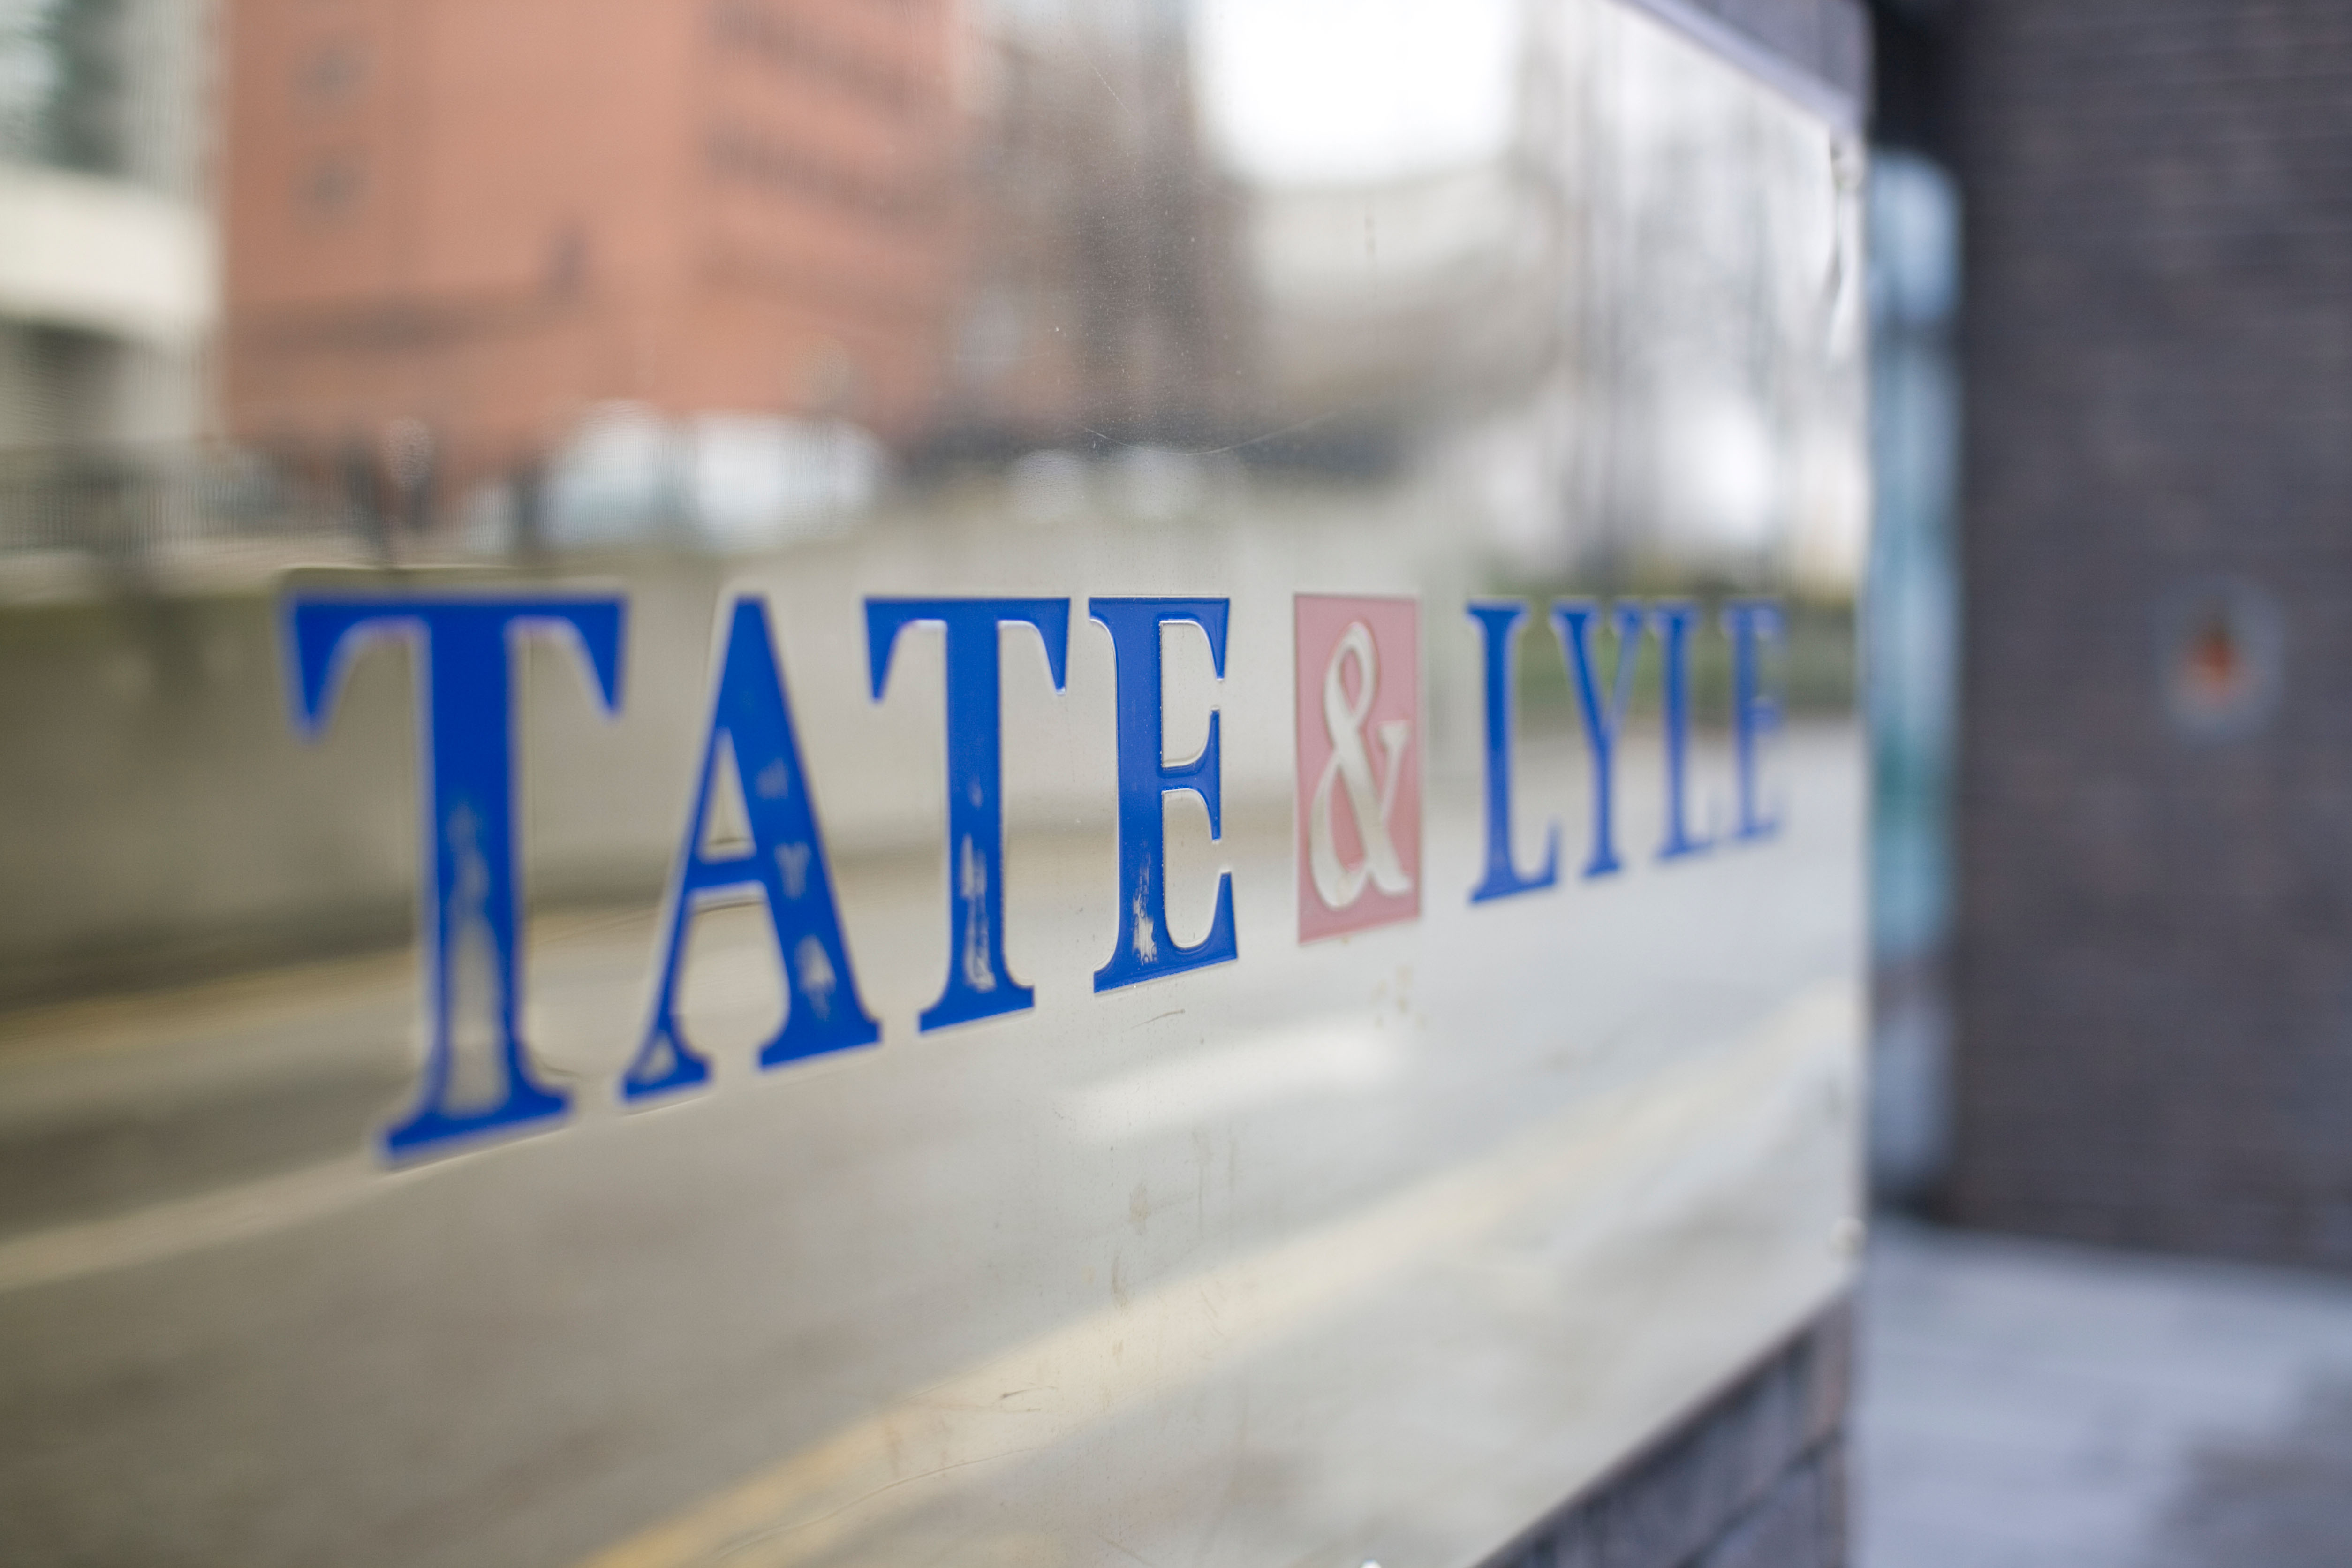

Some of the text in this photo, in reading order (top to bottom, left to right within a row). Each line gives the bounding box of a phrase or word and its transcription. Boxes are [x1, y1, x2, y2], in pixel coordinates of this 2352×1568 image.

[284, 596, 1784, 1160] TATE & LYLE
